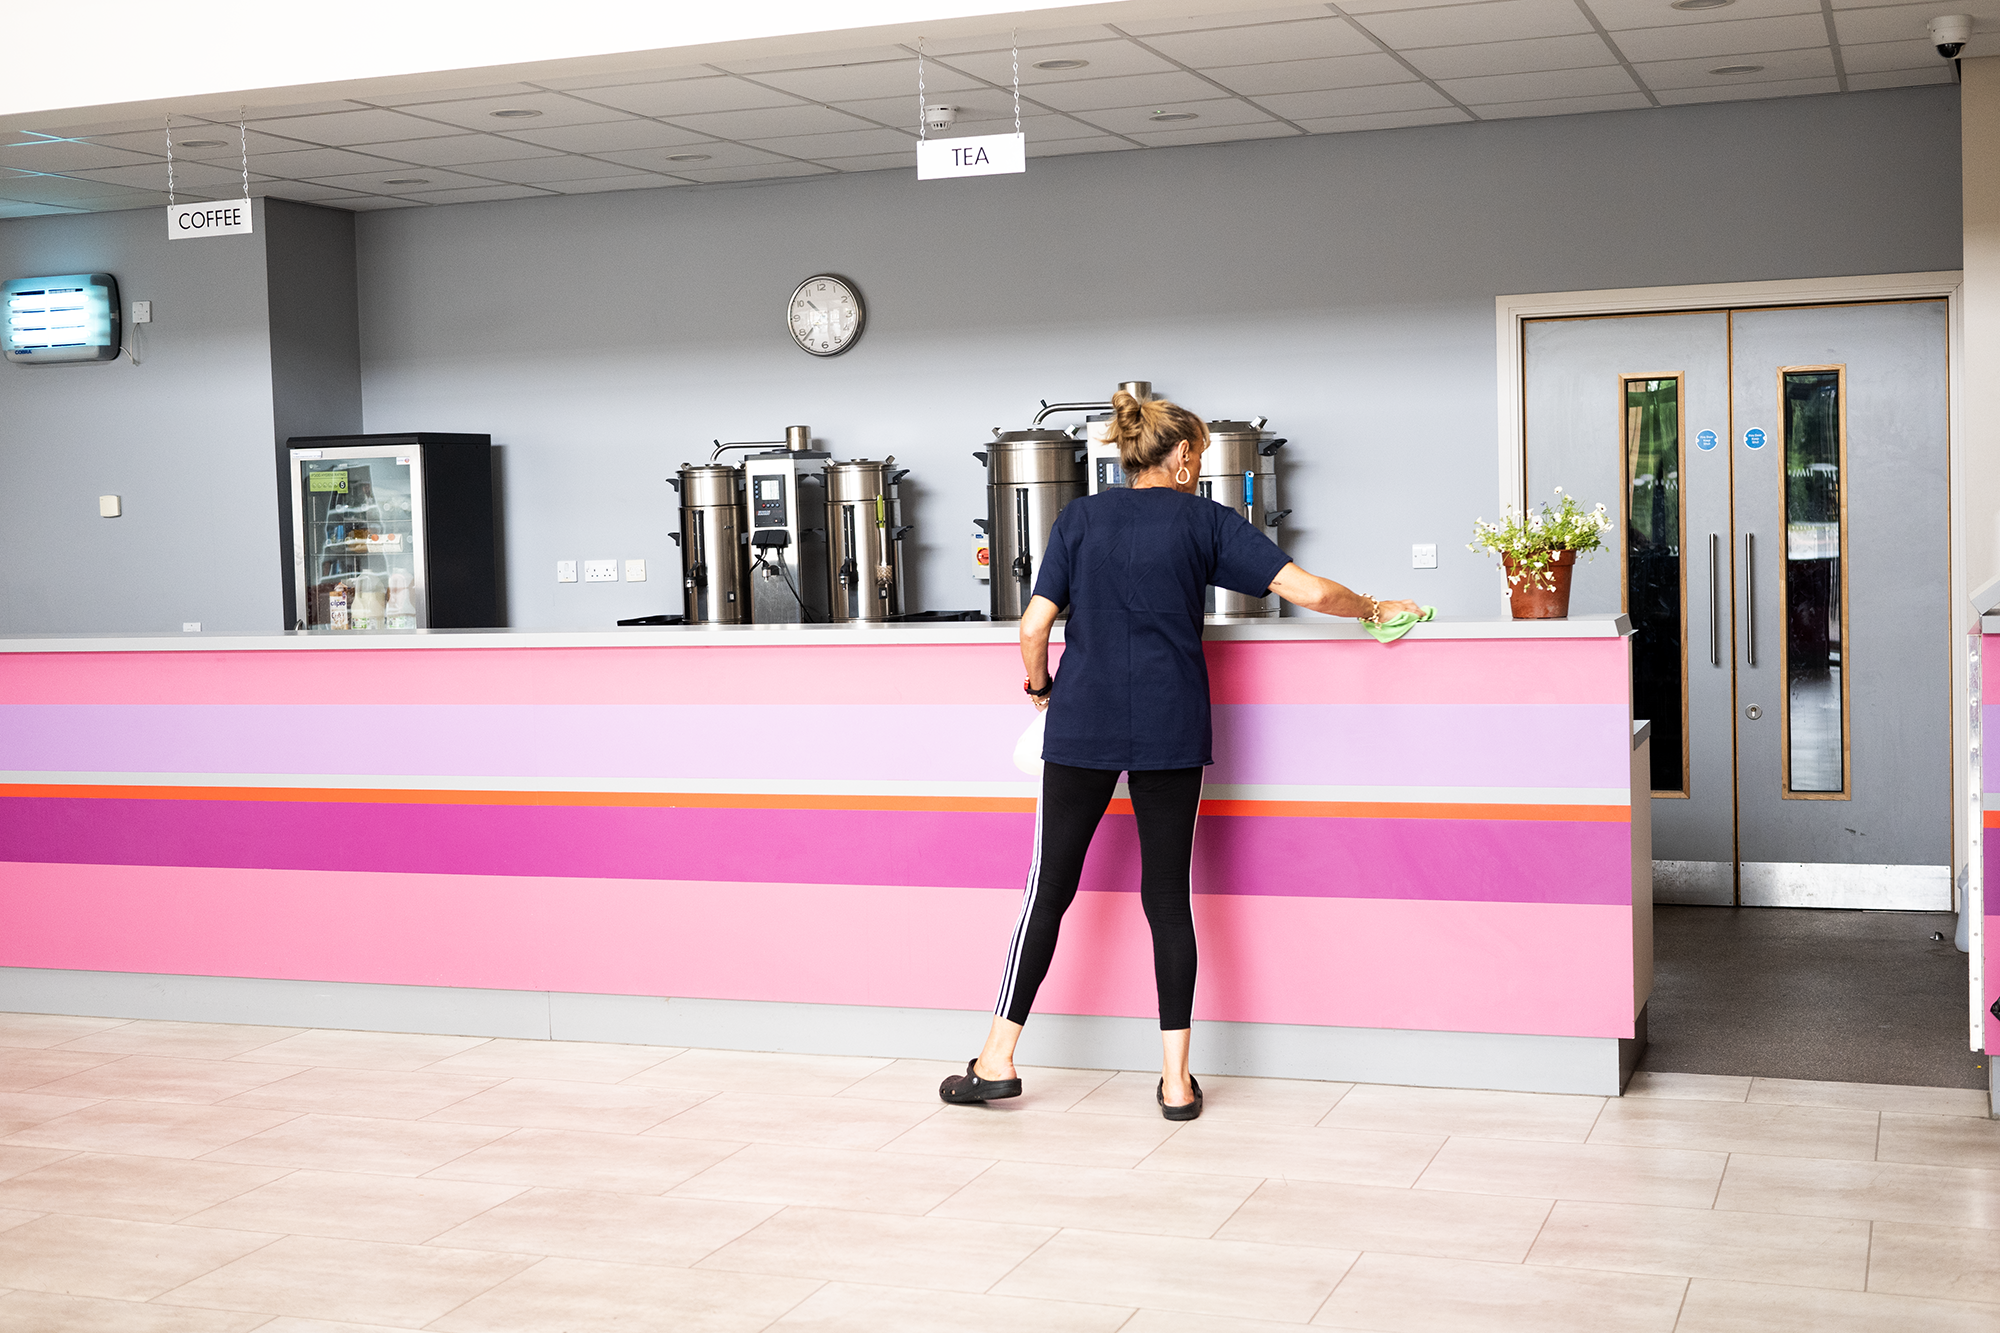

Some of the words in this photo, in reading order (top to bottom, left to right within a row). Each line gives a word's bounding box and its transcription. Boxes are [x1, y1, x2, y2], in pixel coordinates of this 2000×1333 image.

[951, 146, 990, 167] TEA
[178, 208, 242, 230] COFFEE
[816, 283, 826, 291] 12
[832, 285, 836, 293] 1
[805, 289, 811, 297] 11
[796, 299, 805, 308] 10
[840, 295, 848, 304] 2
[845, 309, 853, 318] 3
[793, 314, 801, 323] 9
[798, 328, 806, 337] 8
[808, 338, 815, 347] 7
[834, 335, 842, 344] 5
[821, 341, 829, 349] 6
